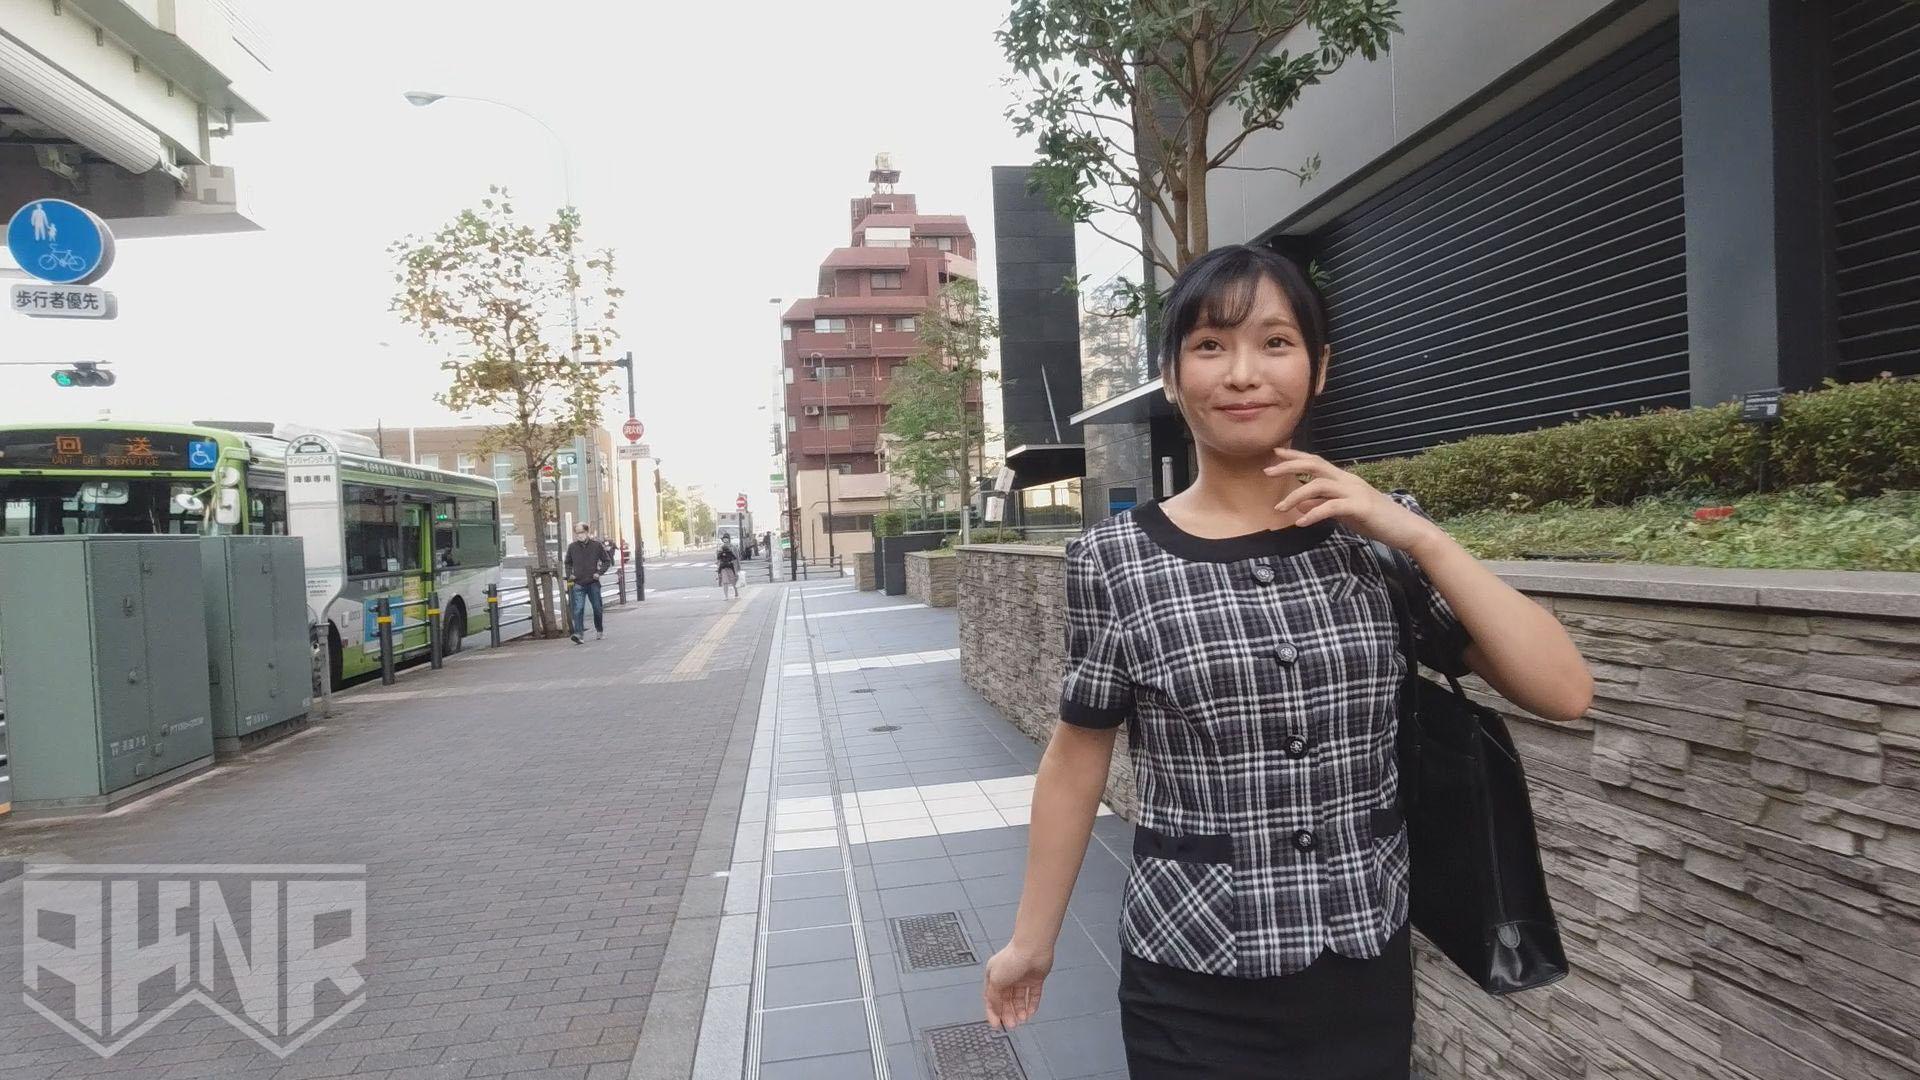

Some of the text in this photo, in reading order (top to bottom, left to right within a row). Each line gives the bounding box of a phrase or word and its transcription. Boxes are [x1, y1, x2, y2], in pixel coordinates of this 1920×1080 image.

[16, 290, 99, 310] 歩行者優先
[56, 436, 152, 456] 回送
[52, 455, 159, 466] OUT OF SERVICE
